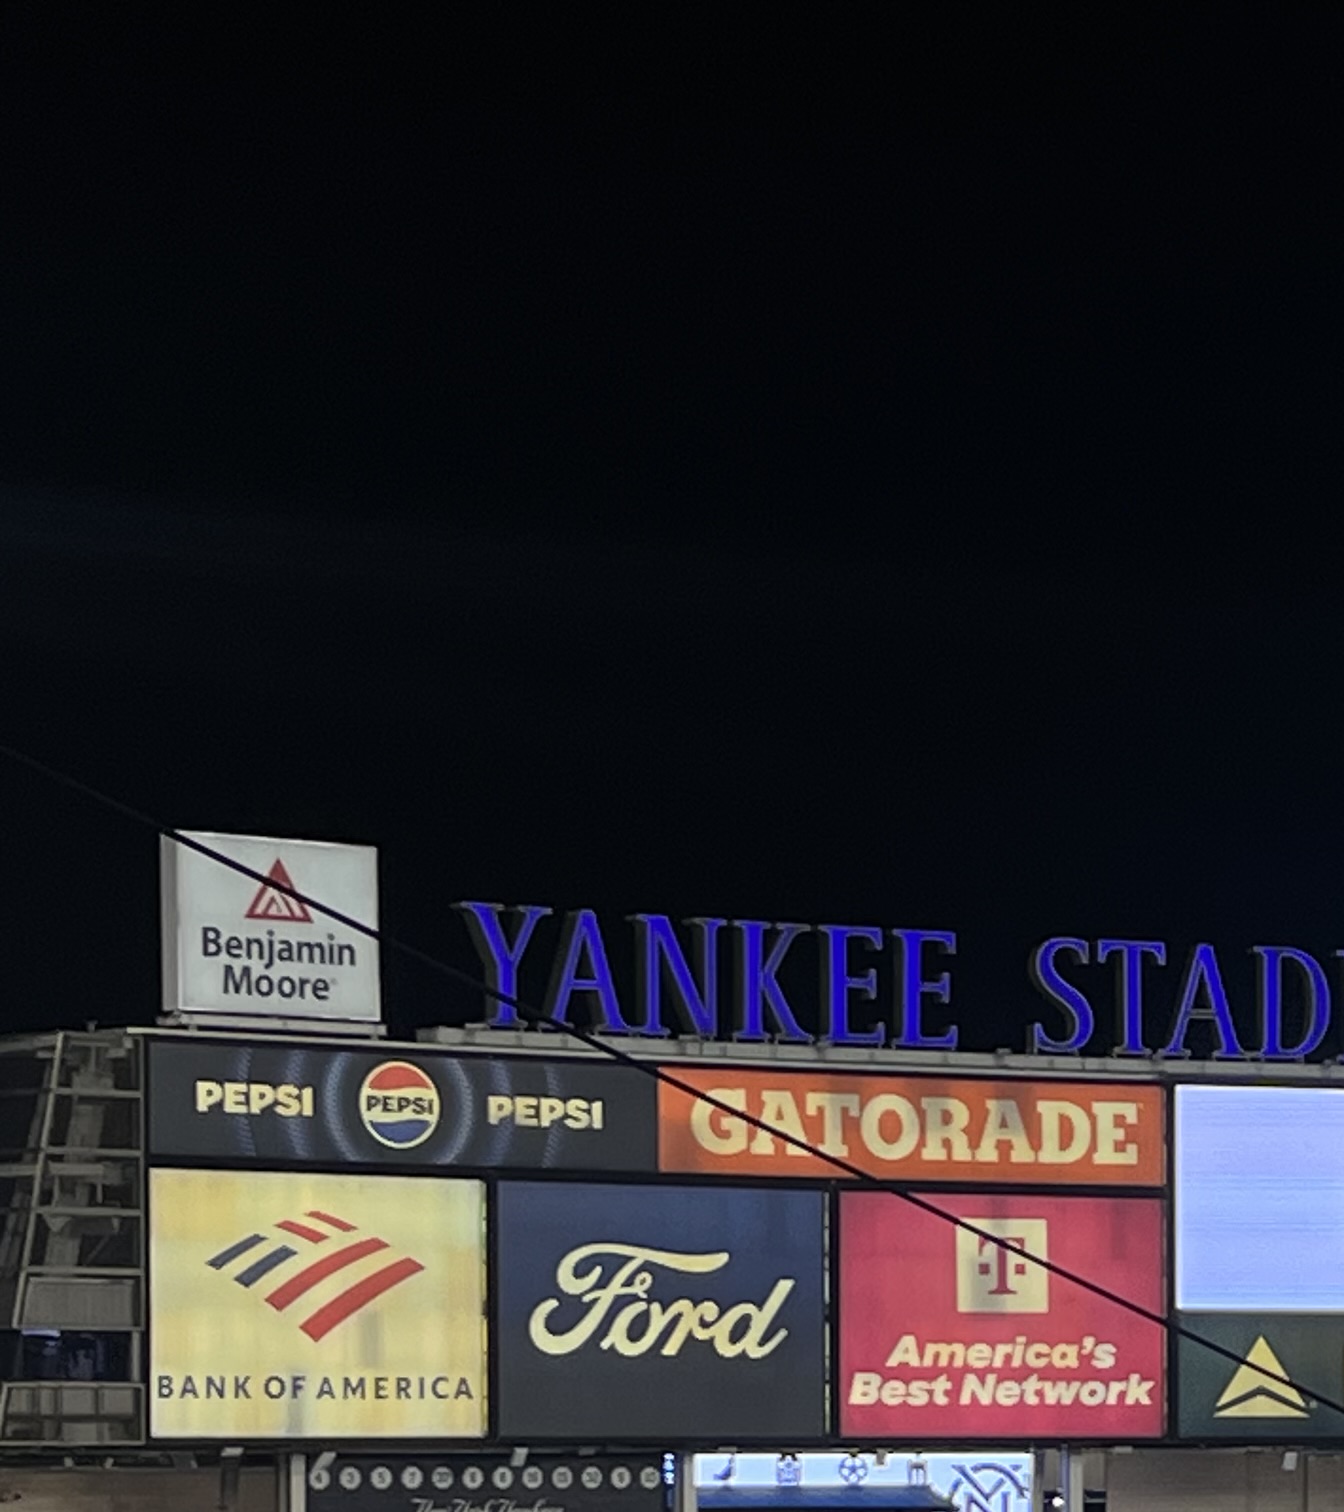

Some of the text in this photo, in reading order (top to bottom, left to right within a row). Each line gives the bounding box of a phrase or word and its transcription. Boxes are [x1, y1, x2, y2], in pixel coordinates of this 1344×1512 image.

[202, 928, 356, 969] Benjamin
[222, 965, 330, 1000] Moore
[463, 900, 957, 1050] YANKEE
[195, 1081, 314, 1116] PEPSI
[365, 1094, 435, 1117] PEPSI
[487, 1095, 603, 1131] PEPSI
[690, 1087, 1138, 1165] GATORADE
[529, 1241, 794, 1358] Ford
[888, 1335, 1116, 1370] America's
[157, 1375, 473, 1401] BANK OF AMERICA
[849, 1373, 1154, 1406] Best Network
